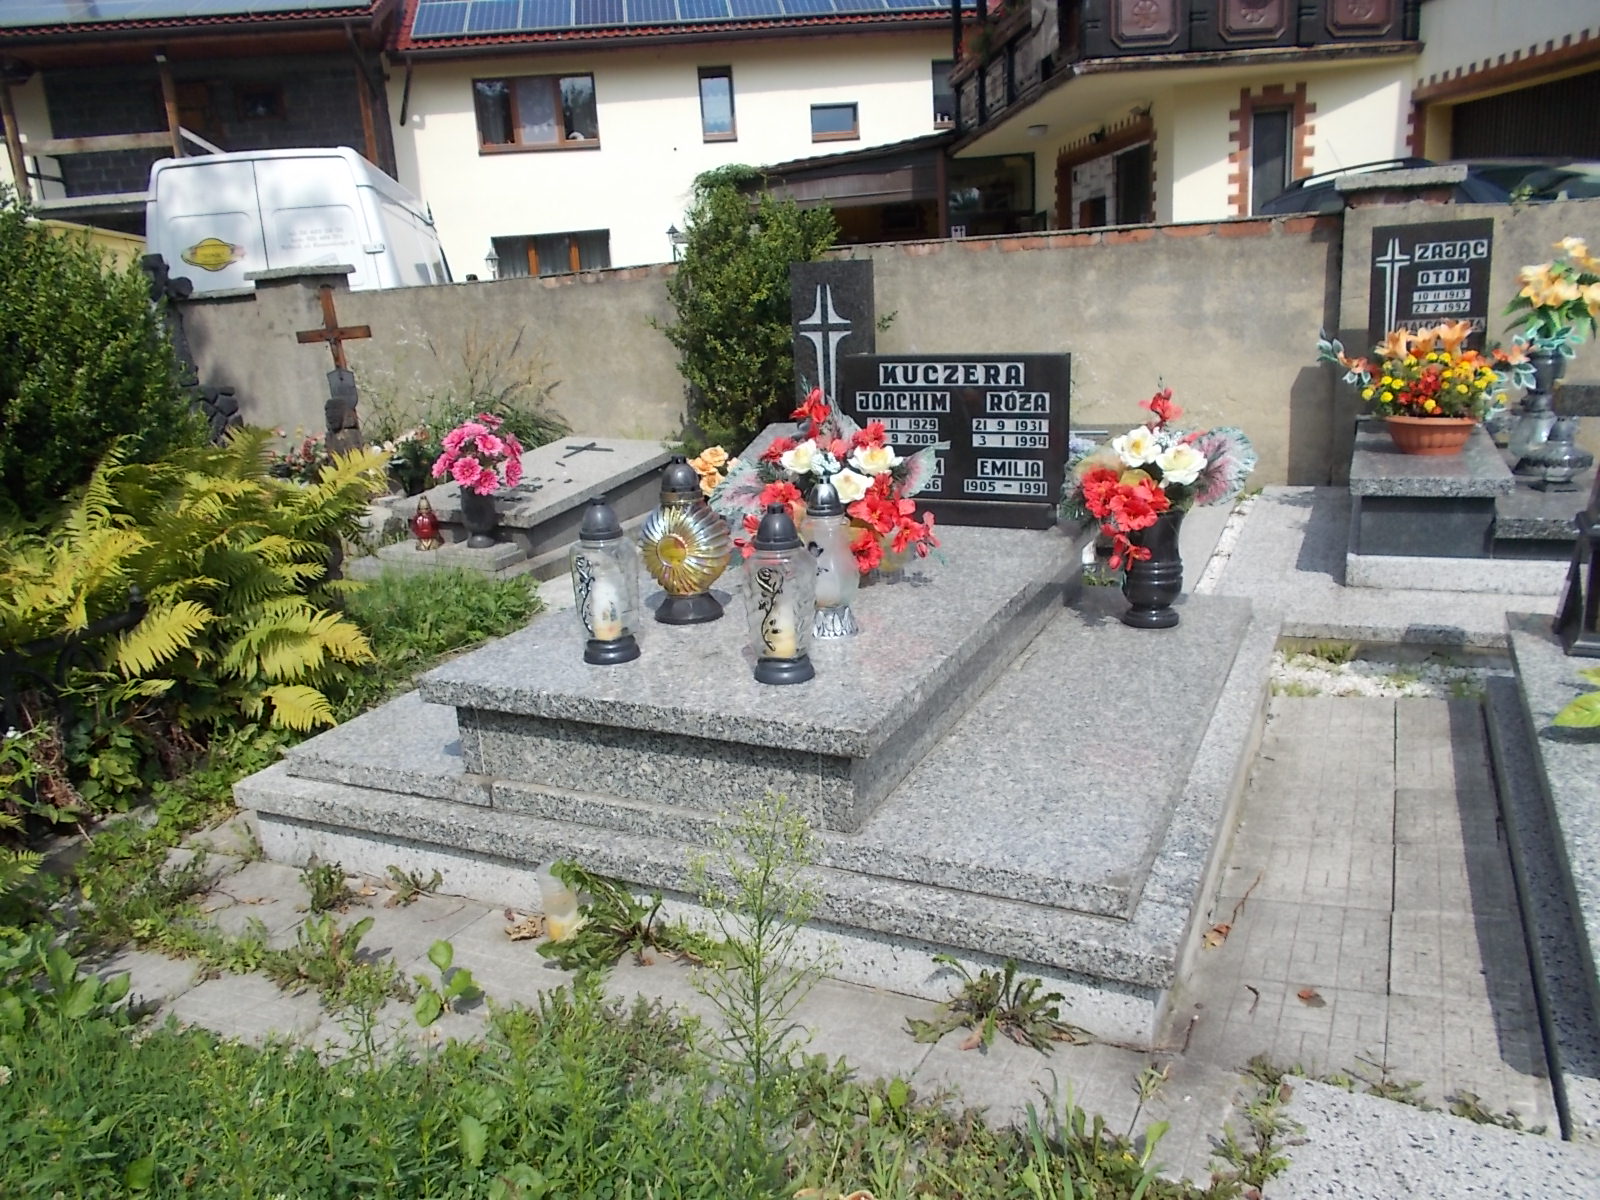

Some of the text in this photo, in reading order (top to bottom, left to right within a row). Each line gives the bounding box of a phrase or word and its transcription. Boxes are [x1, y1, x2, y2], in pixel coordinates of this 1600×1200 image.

[1417, 241, 1485, 262] ZAJĄC
[1420, 269, 1468, 284] OTON
[1418, 292, 1429, 300] 10
[1433, 292, 1440, 300] 11
[881, 364, 1022, 385] KUCZERA
[857, 392, 948, 411] JOACHIM
[890, 419, 899, 429] 11
[909, 419, 937, 430] 1929
[975, 420, 1042, 431] 21 9 1931
[891, 433, 937, 444] 9 2009
[978, 435, 1047, 447] 3 1 1994
[980, 460, 1041, 477] EMILIA
[966, 481, 996, 492] 1905
[1019, 482, 1046, 495] 1991
